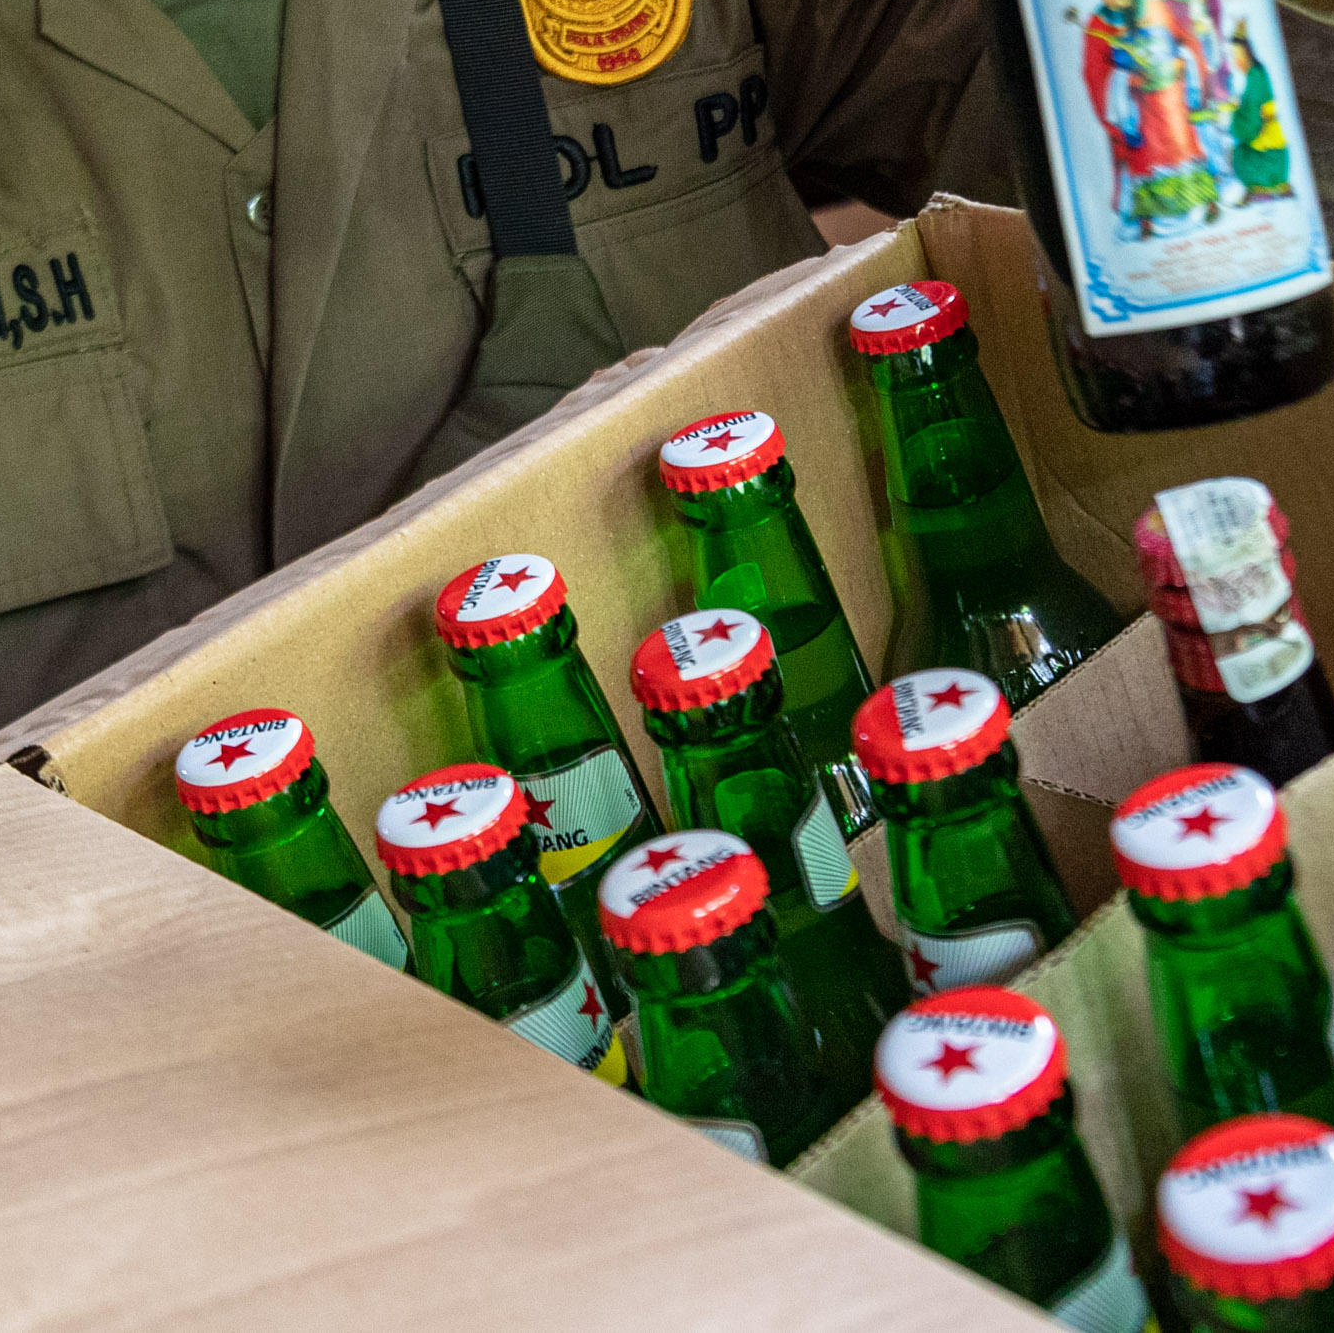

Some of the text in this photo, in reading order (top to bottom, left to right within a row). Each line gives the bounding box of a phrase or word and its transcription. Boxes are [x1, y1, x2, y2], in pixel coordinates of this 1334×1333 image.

[895, 283, 937, 310] BINTANG
[670, 412, 758, 448] BINTANG
[459, 557, 502, 612] BINTANG
[662, 621, 697, 671] BINTANG
[193, 718, 288, 749] BINTANG
[892, 681, 925, 739] BINTANG
[395, 776, 499, 806] BINTANG
[1123, 772, 1242, 828] BINTANG
[628, 846, 737, 907] BINTANG
